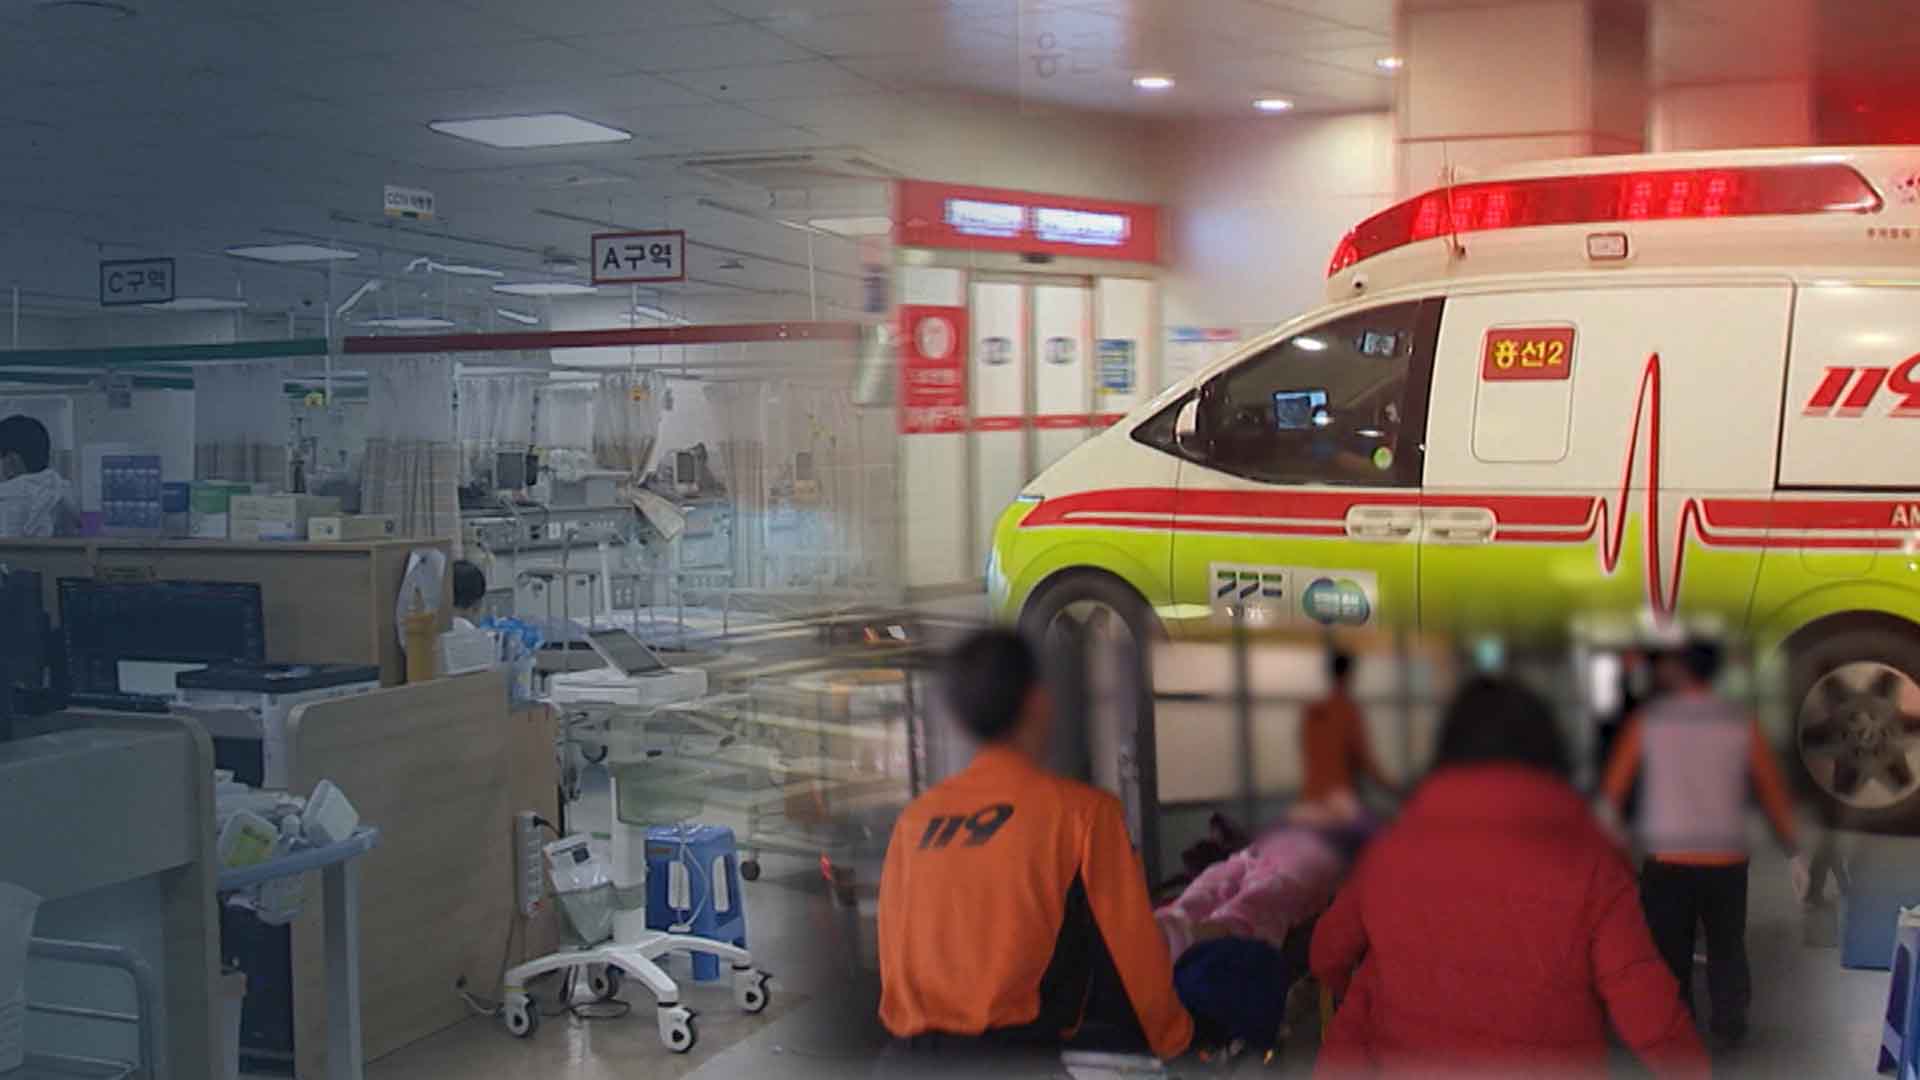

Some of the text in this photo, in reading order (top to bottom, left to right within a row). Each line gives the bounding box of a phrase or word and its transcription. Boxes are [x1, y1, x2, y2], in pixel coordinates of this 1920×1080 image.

[602, 243, 672, 271] A구역
[108, 270, 166, 293] C구역
[918, 803, 1015, 848] 119
